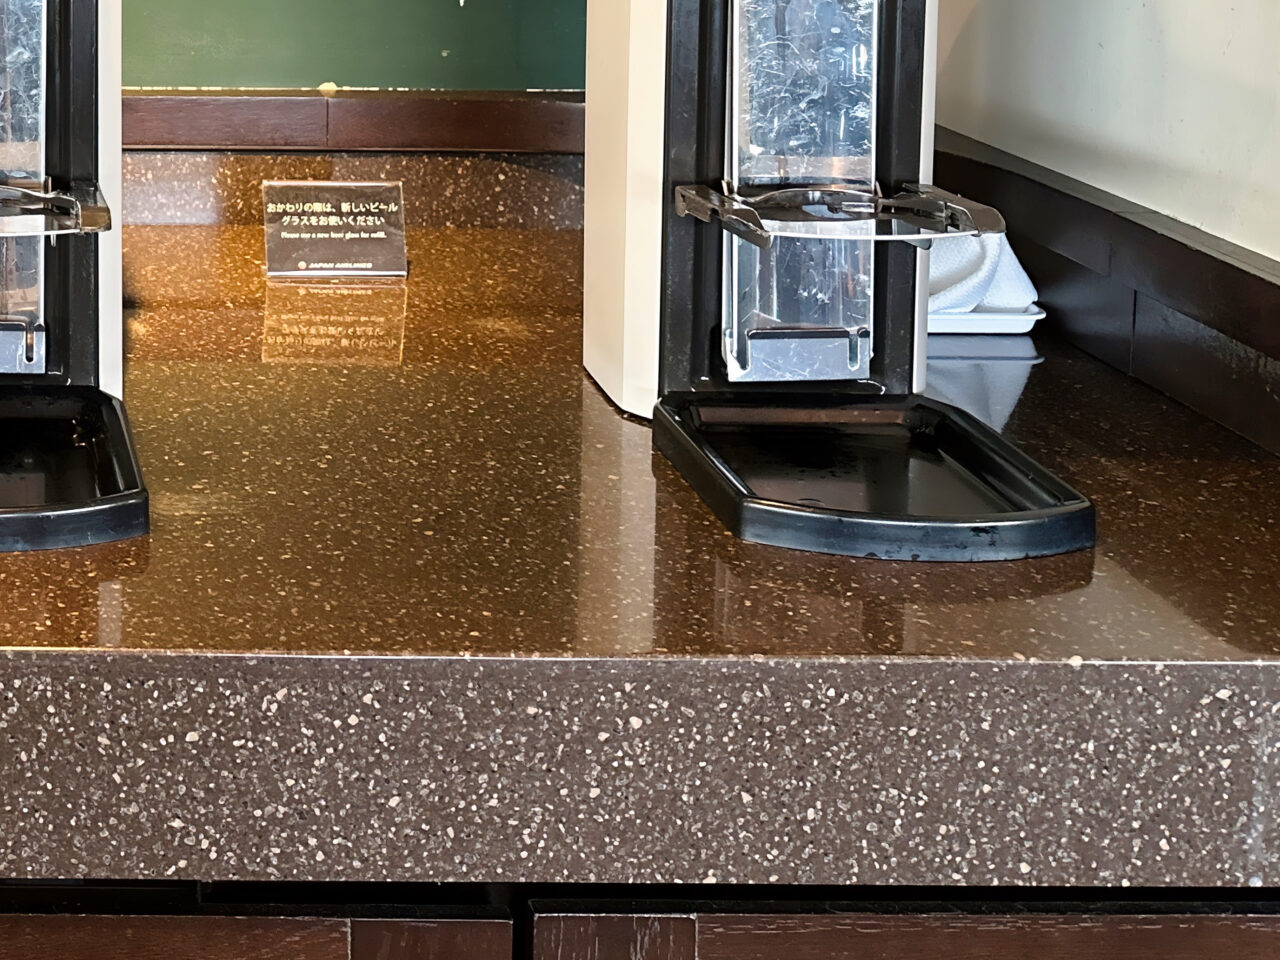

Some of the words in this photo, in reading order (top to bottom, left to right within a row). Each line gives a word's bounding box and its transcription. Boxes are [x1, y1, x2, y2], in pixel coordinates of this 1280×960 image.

[282, 216, 386, 226] グラスをお使いください
